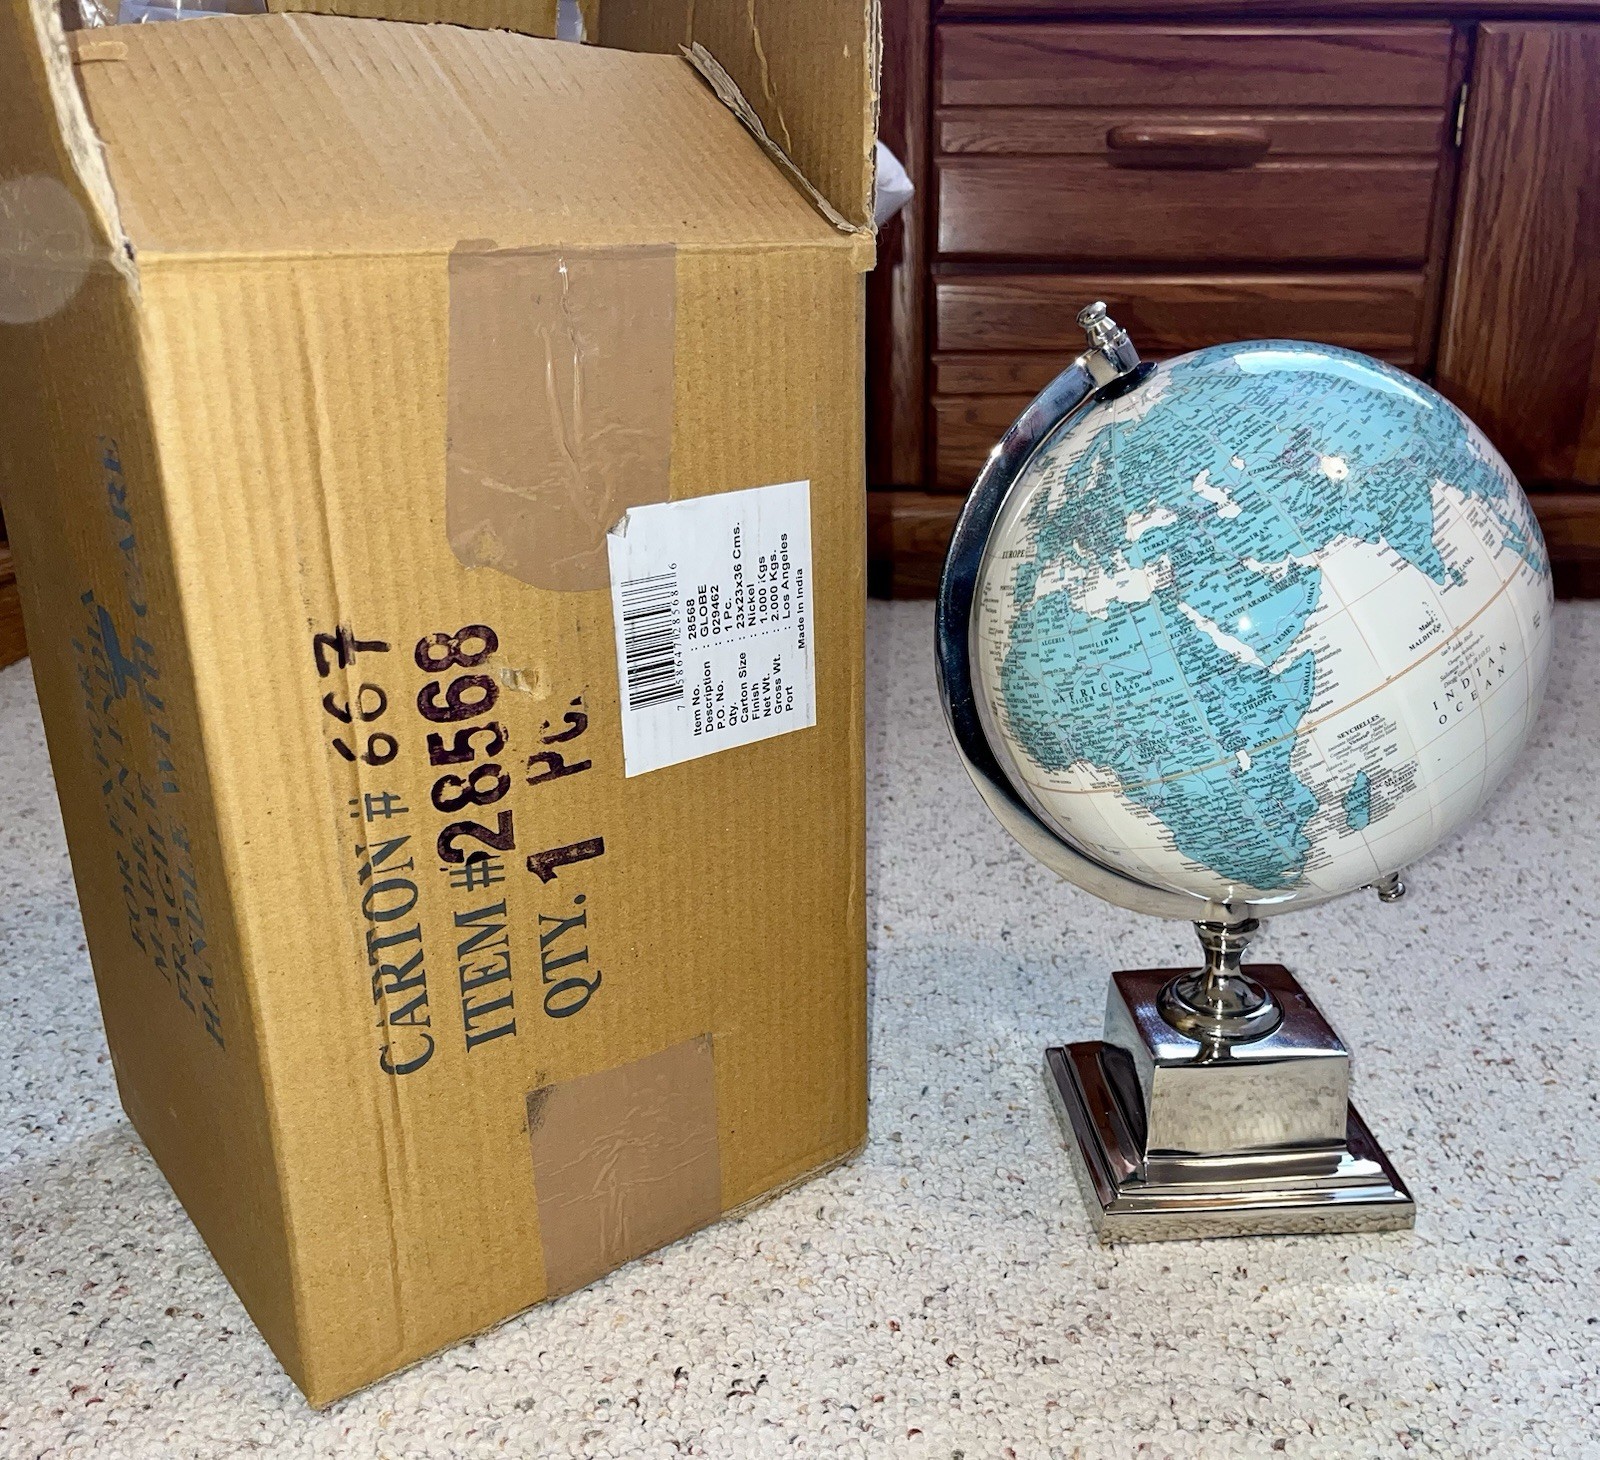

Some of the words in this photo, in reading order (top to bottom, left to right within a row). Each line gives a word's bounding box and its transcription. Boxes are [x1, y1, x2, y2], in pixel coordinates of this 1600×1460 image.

[1316, 504, 1349, 528] PAKISTAN
[733, 522, 742, 559] Cms.
[1143, 538, 1170, 553] TURKEY
[1249, 526, 1270, 541] IRAN
[769, 549, 779, 581] Kgs.
[780, 533, 790, 590] Angeles
[1002, 549, 1025, 560] EUROPE
[1197, 546, 1216, 558] IRAQ
[734, 563, 745, 629] 23x23x36
[746, 583, 756, 627] Nickel
[758, 588, 768, 624] 1.000
[770, 586, 779, 622] 2.000
[1223, 606, 1246, 620] SAUDI
[1247, 593, 1274, 610] ARABIA
[1306, 581, 1317, 605] OMAN
[686, 598, 696, 640] 28568
[698, 584, 709, 637] GLOBE
[710, 585, 721, 635] 029462
[723, 597, 732, 620] Pc.
[782, 594, 791, 620] Los
[724, 624, 733, 632] 1
[797, 615, 805, 649] Made
[1170, 627, 1193, 640] EGYPT
[1273, 622, 1296, 646] YEMEN
[1041, 637, 1066, 647] ALGERIA
[1094, 636, 1120, 648] LIBYA
[738, 652, 747, 678] Size
[772, 654, 781, 675] Wt.
[1432, 642, 1508, 711] INDIAN
[715, 680, 724, 703] No.
[762, 673, 771, 694] Wt.
[1058, 679, 1123, 704] AFRICA
[1115, 682, 1140, 694] CHAD
[1152, 676, 1176, 688] SUDAN
[1303, 660, 1313, 697] SOMALIA
[313, 624, 398, 766] 667
[692, 684, 701, 706] No.
[702, 661, 714, 733] Description
[740, 682, 748, 723] Carton
[752, 683, 760, 721] Finish
[762, 695, 771, 717] Net
[774, 678, 782, 714] Gross
[785, 685, 794, 712] Port
[1070, 697, 1095, 706] NIGER
[1237, 694, 1278, 713] ETHIOPIA
[1438, 664, 1506, 725] OCEAN
[693, 709, 702, 736] Item
[716, 707, 726, 730] P.O.
[728, 702, 738, 727] Qty.
[1174, 716, 1198, 727] SOUTH
[1337, 713, 1381, 740] SEYCHELLES
[1253, 735, 1278, 749] KENYA
[114, 757, 138, 817] IN
[1347, 778, 1394, 803] MADAGASCAR
[526, 837, 604, 884] 1
[115, 851, 147, 954] FOR
[128, 827, 172, 986] MADE
[136, 771, 197, 1020] FRAGILE
[168, 815, 227, 1052] HANDLE
[355, 834, 434, 1075] CARTON
[538, 894, 602, 1019] QTY.
[454, 897, 516, 1053] ITEM
